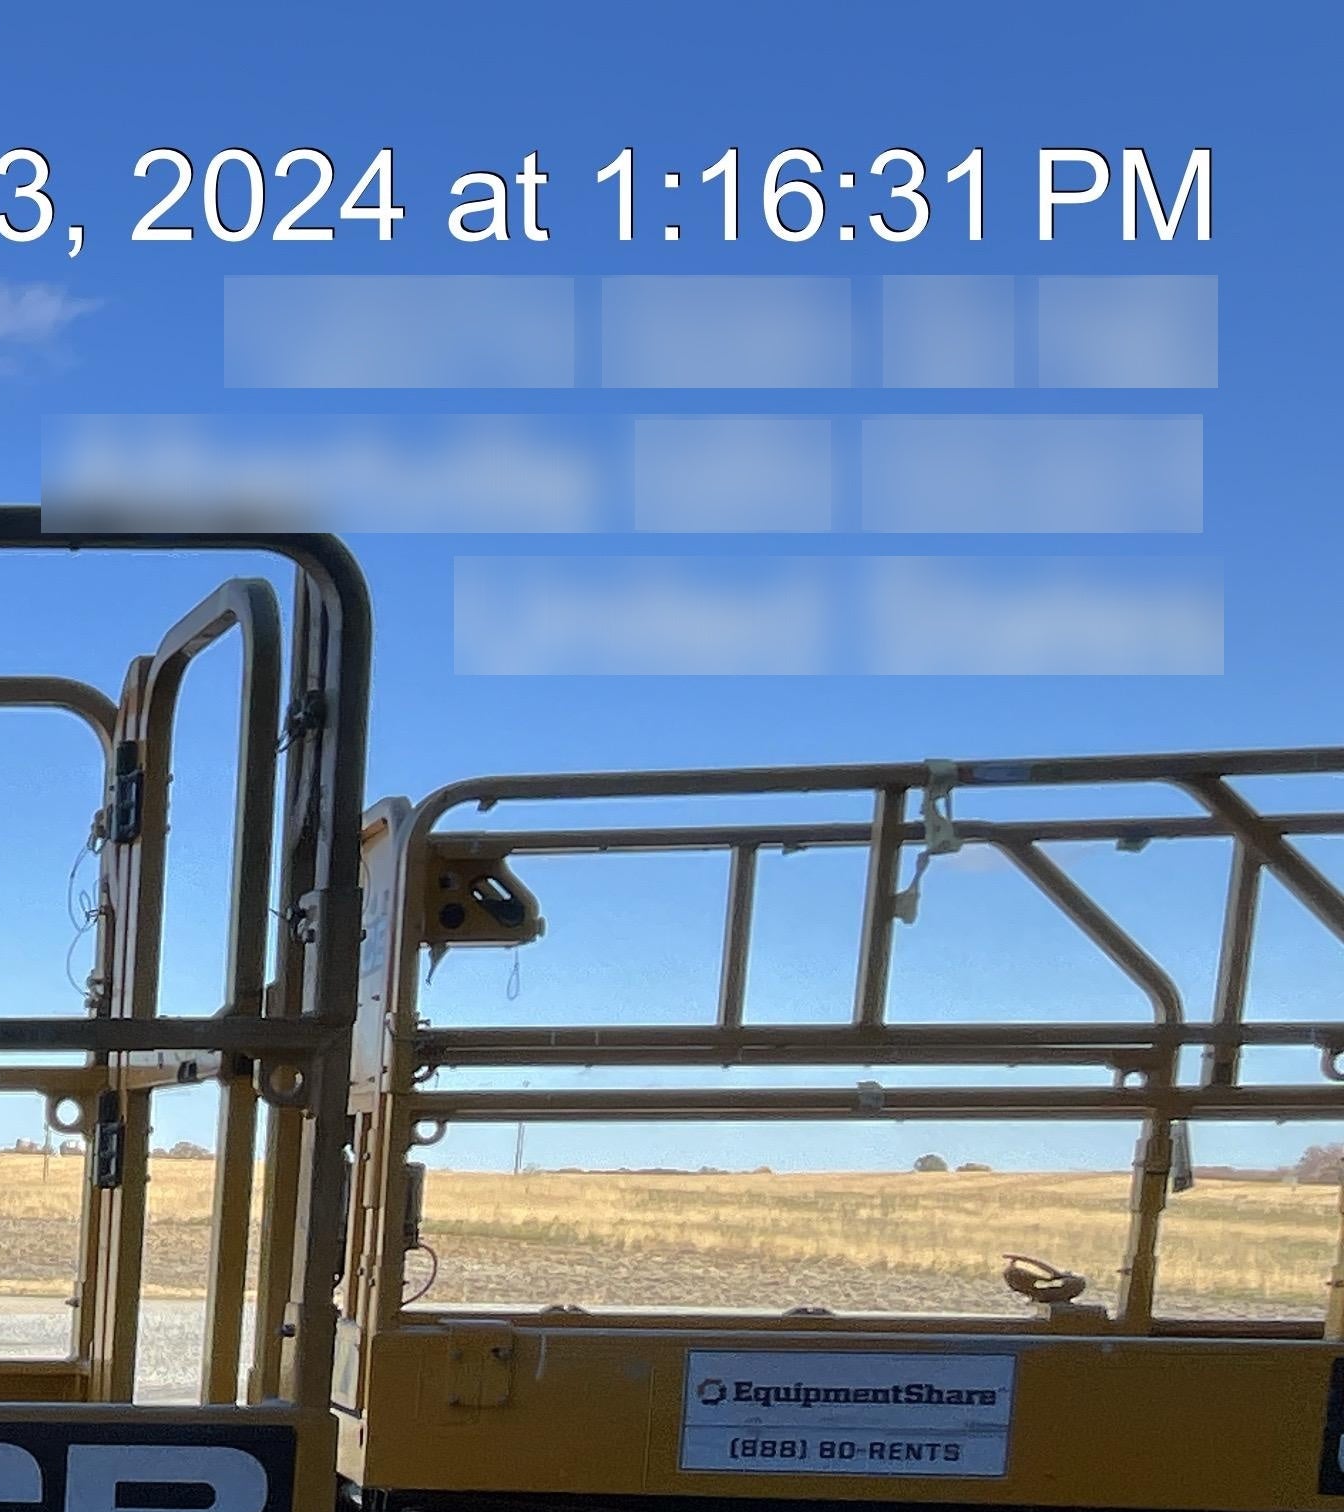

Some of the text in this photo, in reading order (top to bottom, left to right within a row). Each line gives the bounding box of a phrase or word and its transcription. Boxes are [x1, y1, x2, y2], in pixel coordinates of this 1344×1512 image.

[732, 1380, 998, 1409] EquipmentShare
[729, 1437, 961, 1462] (888) 80-RENTS
